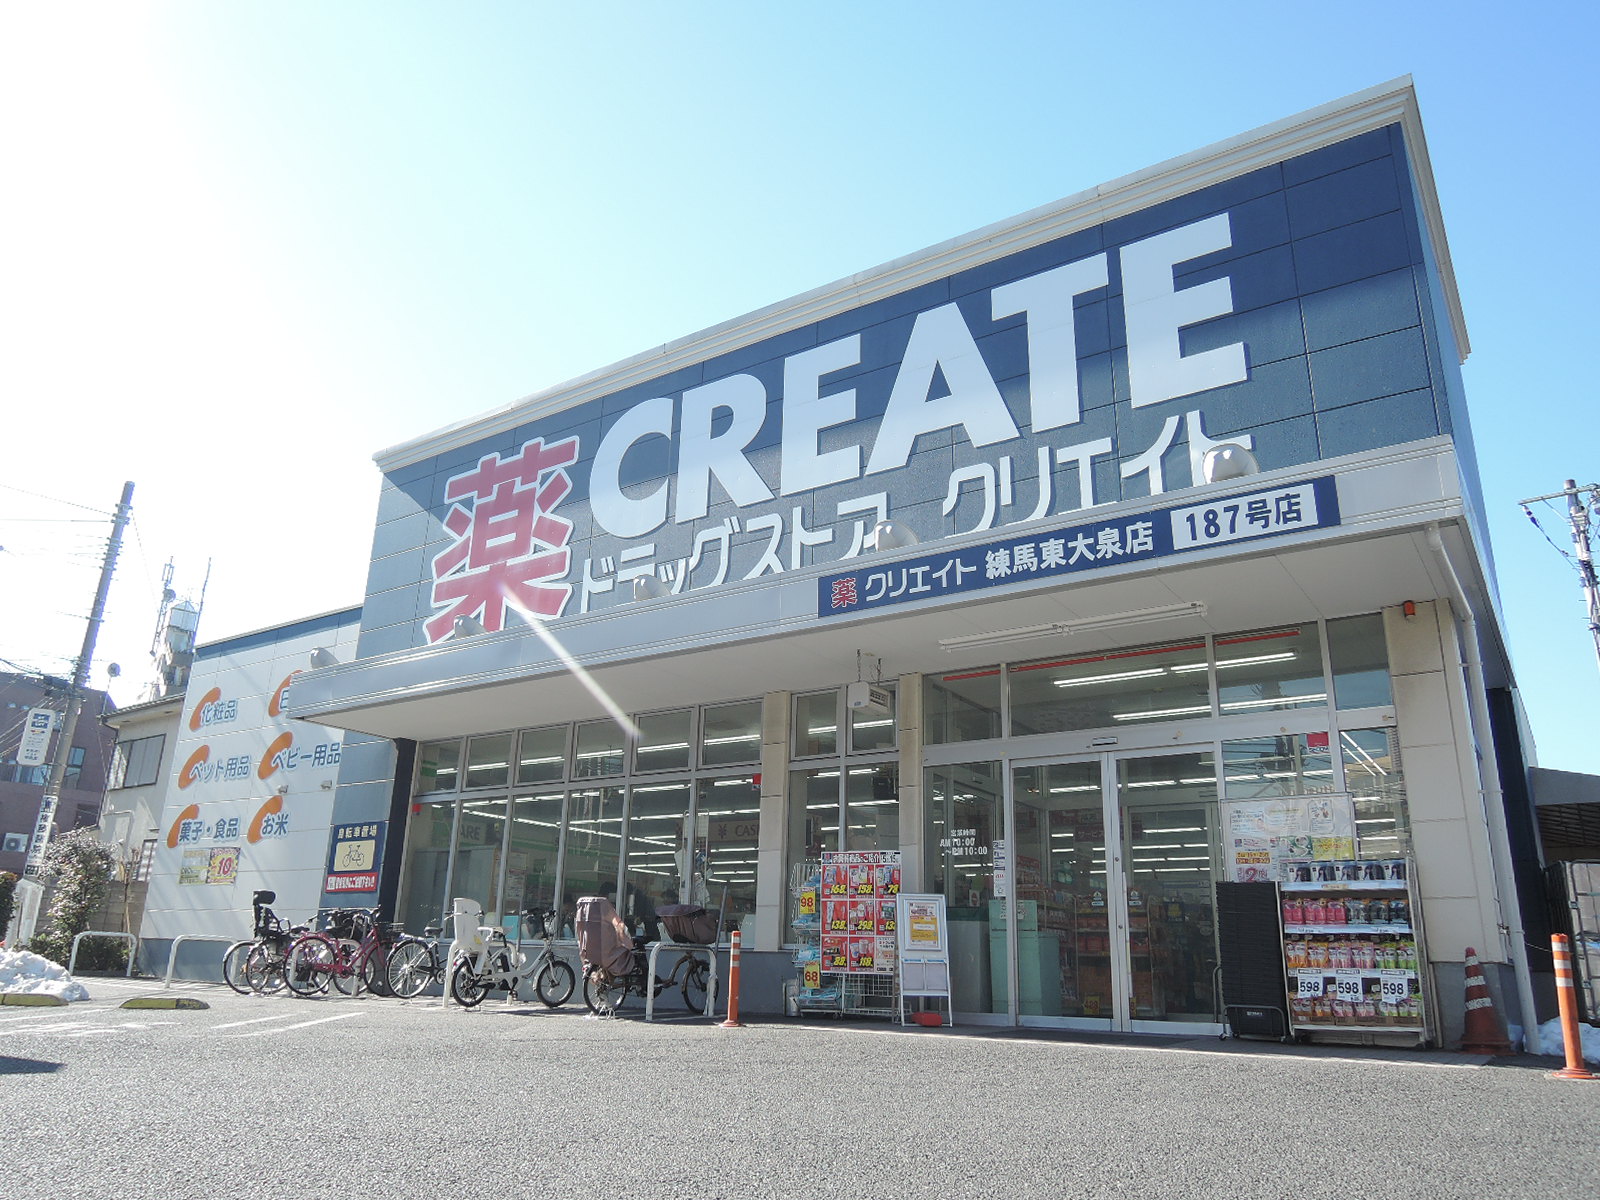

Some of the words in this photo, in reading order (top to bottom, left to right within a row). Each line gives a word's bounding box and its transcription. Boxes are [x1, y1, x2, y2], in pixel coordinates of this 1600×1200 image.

[590, 212, 1249, 539] CREATE
[580, 492, 888, 615] ドラッグストア
[942, 409, 1252, 538] クリエイト
[423, 435, 580, 645] 薬
[831, 578, 857, 608] 薬
[865, 557, 976, 601] クリエイト
[985, 521, 1154, 579] 練馬東大泉店
[1185, 493, 1303, 541] 187号店
[201, 700, 237, 724] 化粧品
[272, 742, 341, 770] ベビー用品
[190, 755, 250, 783] ペット用品
[178, 817, 239, 843] 菓子・食品
[262, 814, 289, 836] お米
[800, 897, 814, 907] 98
[805, 971, 818, 981] 68
[1299, 981, 1320, 992] 598
[1338, 982, 1359, 994] 598
[1382, 983, 1404, 995] 598
